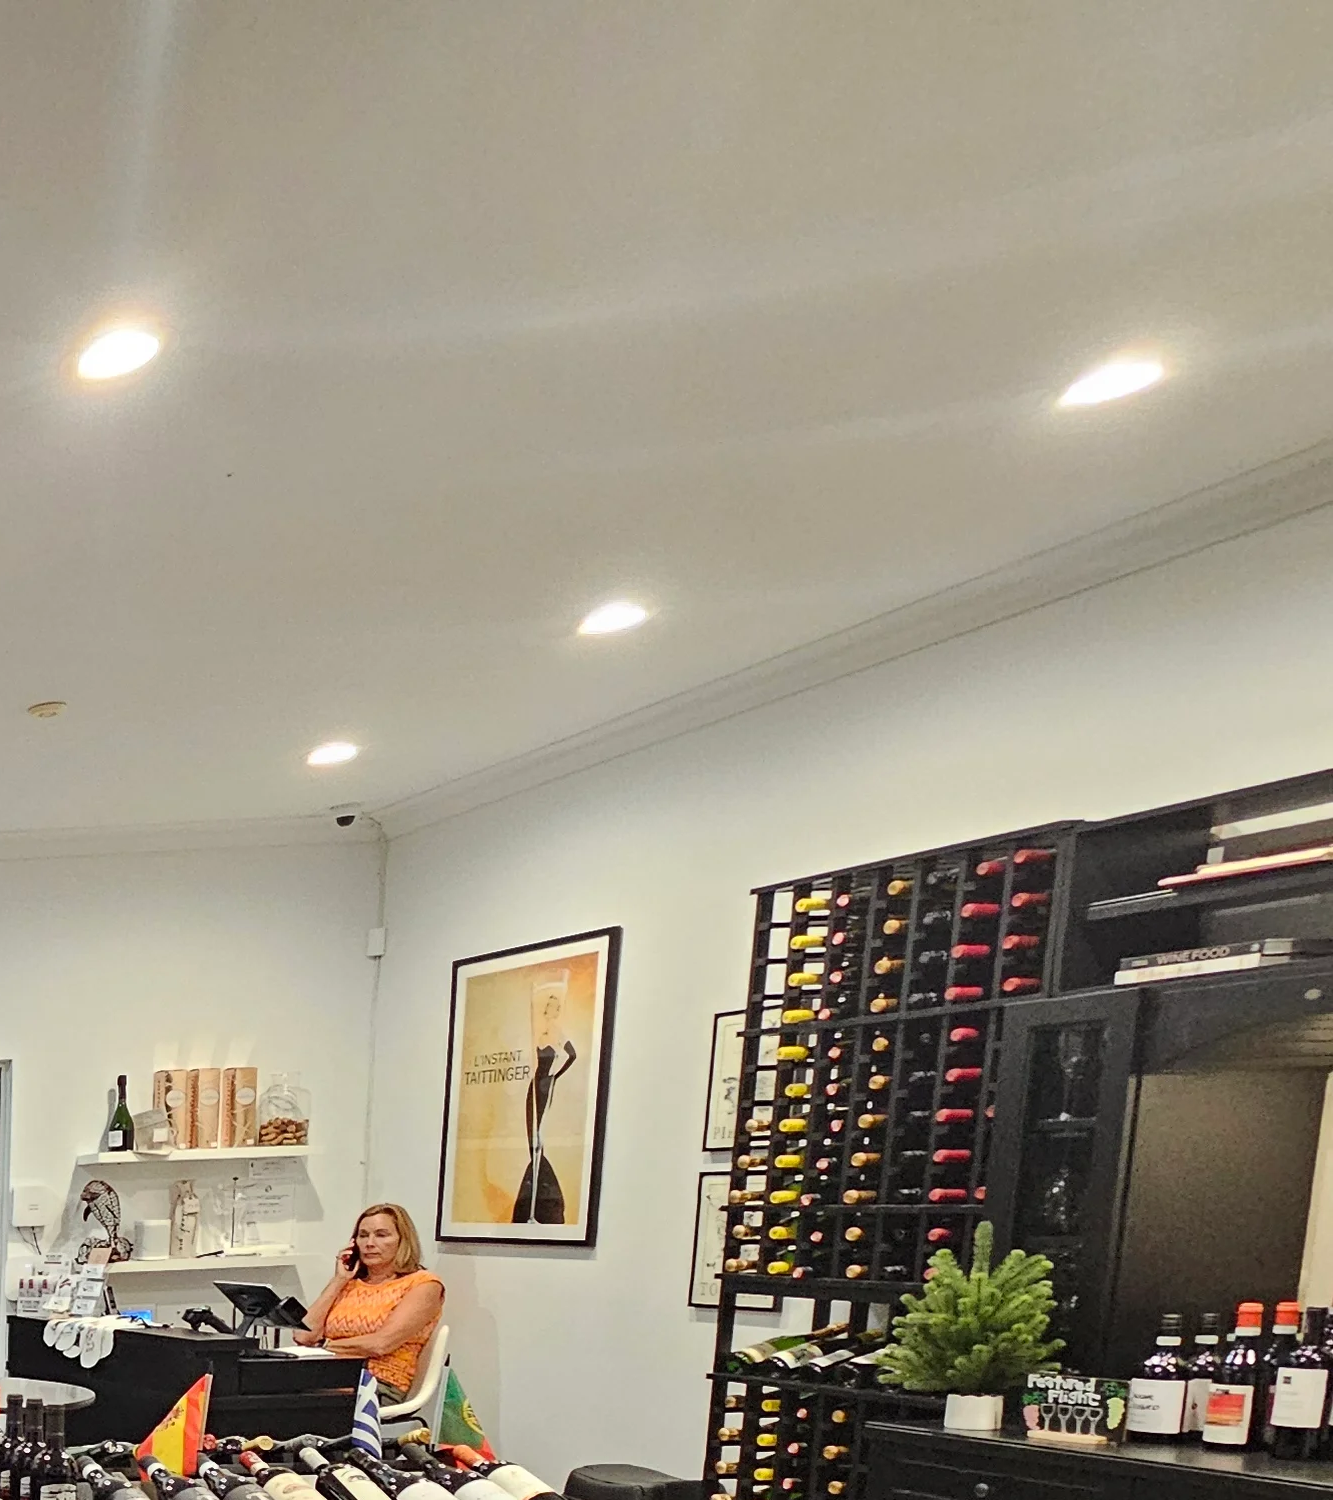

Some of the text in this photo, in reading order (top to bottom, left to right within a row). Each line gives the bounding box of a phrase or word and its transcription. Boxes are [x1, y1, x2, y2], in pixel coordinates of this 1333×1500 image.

[473, 1049, 523, 1067] L'INSTANT
[464, 1065, 531, 1086] TAITTINGER
[1027, 1373, 1096, 1393] Featured
[1047, 1389, 1102, 1407] Flight
